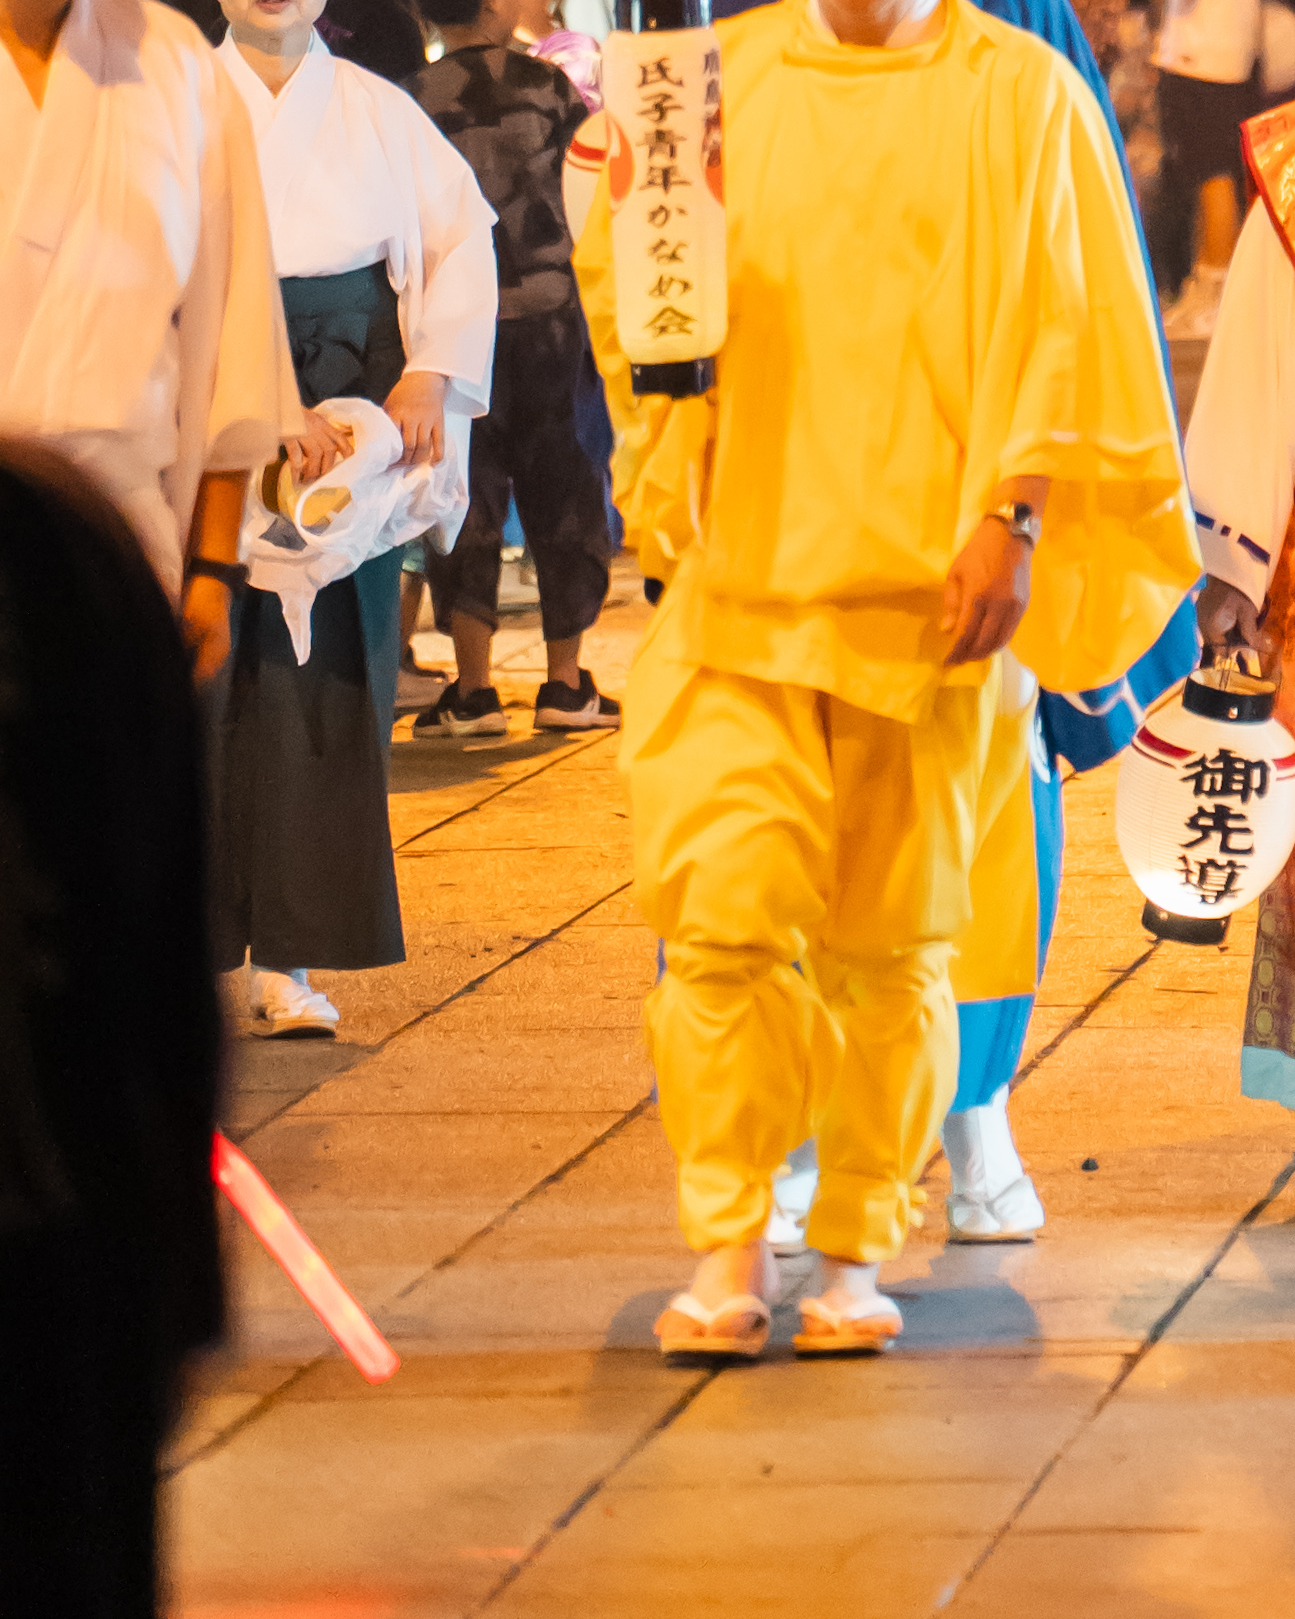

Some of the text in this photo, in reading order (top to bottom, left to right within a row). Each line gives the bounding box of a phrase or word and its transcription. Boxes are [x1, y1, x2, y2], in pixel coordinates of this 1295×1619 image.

[635, 56, 698, 338] 氏子青年かなめ会
[1177, 747, 1271, 906] 御先導
